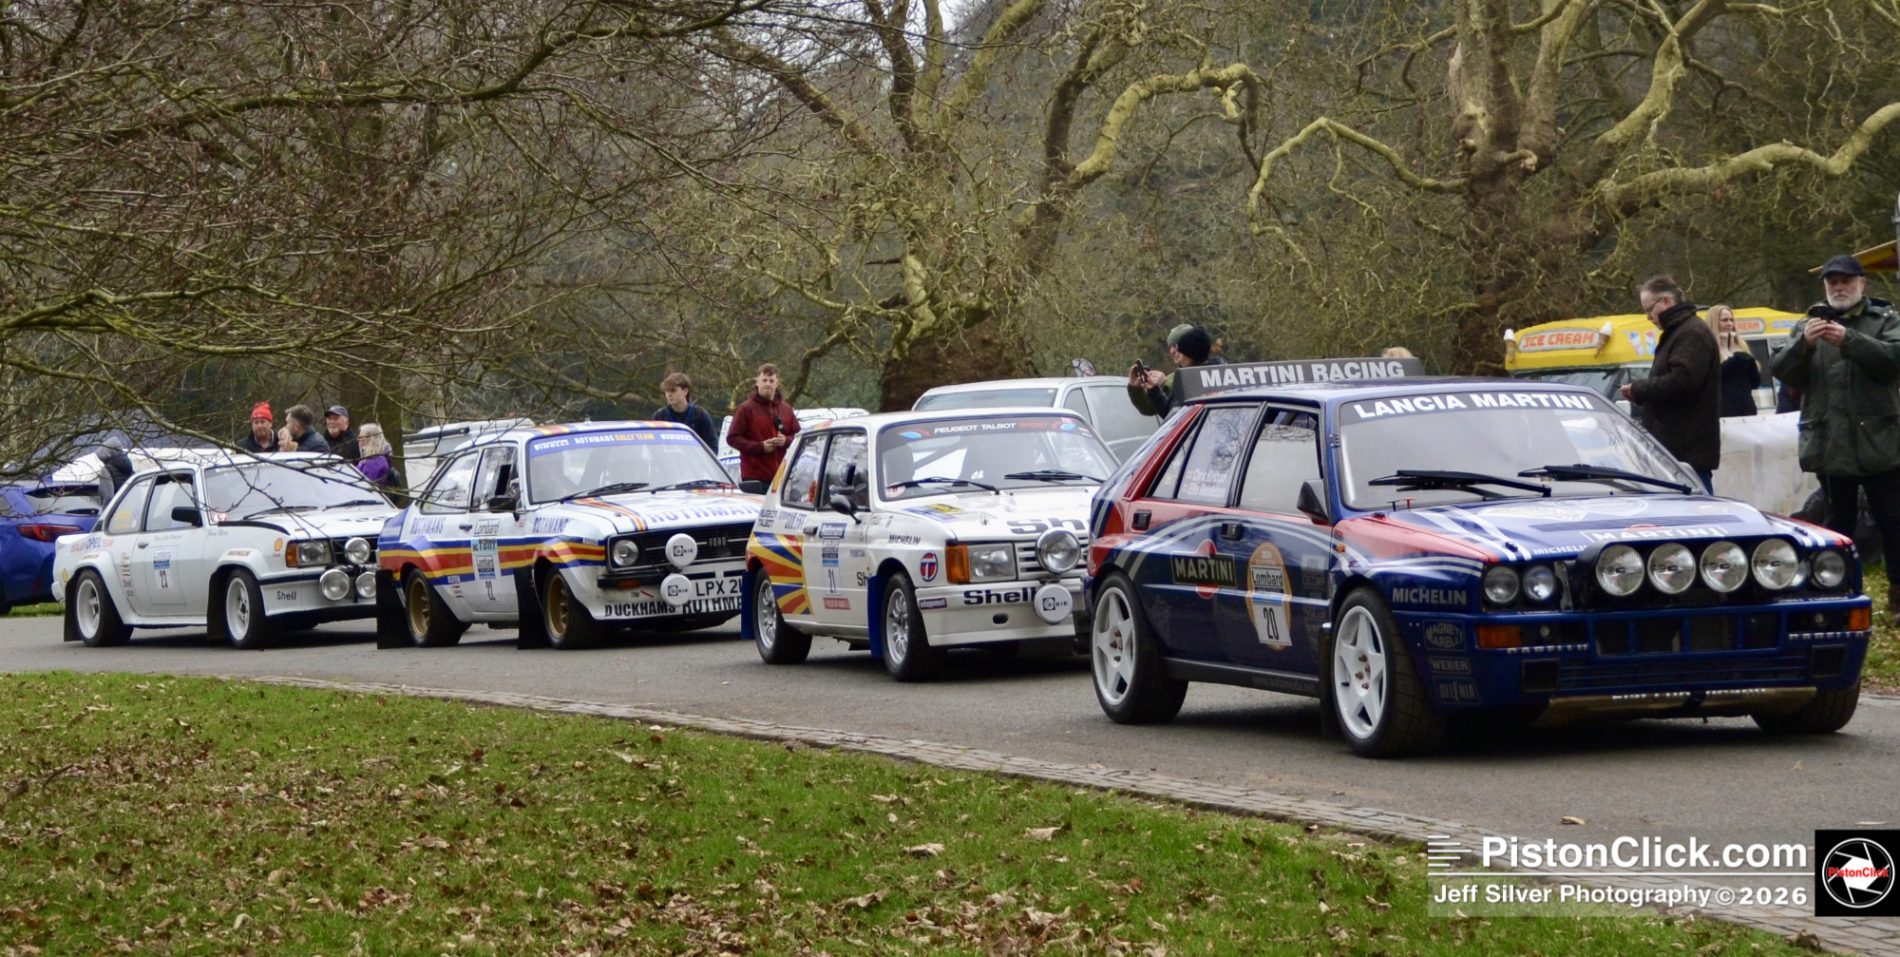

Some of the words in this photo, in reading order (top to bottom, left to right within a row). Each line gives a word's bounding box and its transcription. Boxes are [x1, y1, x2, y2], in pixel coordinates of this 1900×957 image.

[1523, 334, 1545, 348] ICE
[1548, 331, 1595, 346] CREAM
[1200, 363, 1304, 388] MARTINI
[1311, 361, 1404, 382] RACING
[1353, 394, 1465, 419] LANCIA
[1469, 392, 1594, 410] MARTINI
[934, 424, 978, 434] PEUGEOT
[980, 422, 1016, 430] TALBOT
[1006, 517, 1086, 535] Sh
[1591, 526, 1724, 542] MARTINI
[887, 534, 922, 546] MICHELIN
[1174, 558, 1234, 582] MARTINI
[1252, 570, 1284, 586] Lombard
[276, 590, 296, 600] Shell
[485, 580, 496, 601] 22
[695, 580, 724, 597] LPX
[963, 587, 1036, 606] Shell
[1392, 588, 1467, 605] MICHELIN
[604, 602, 676, 617] DUCKHAMS
[1263, 607, 1279, 640] 20
[1431, 659, 1469, 671] WEBER
